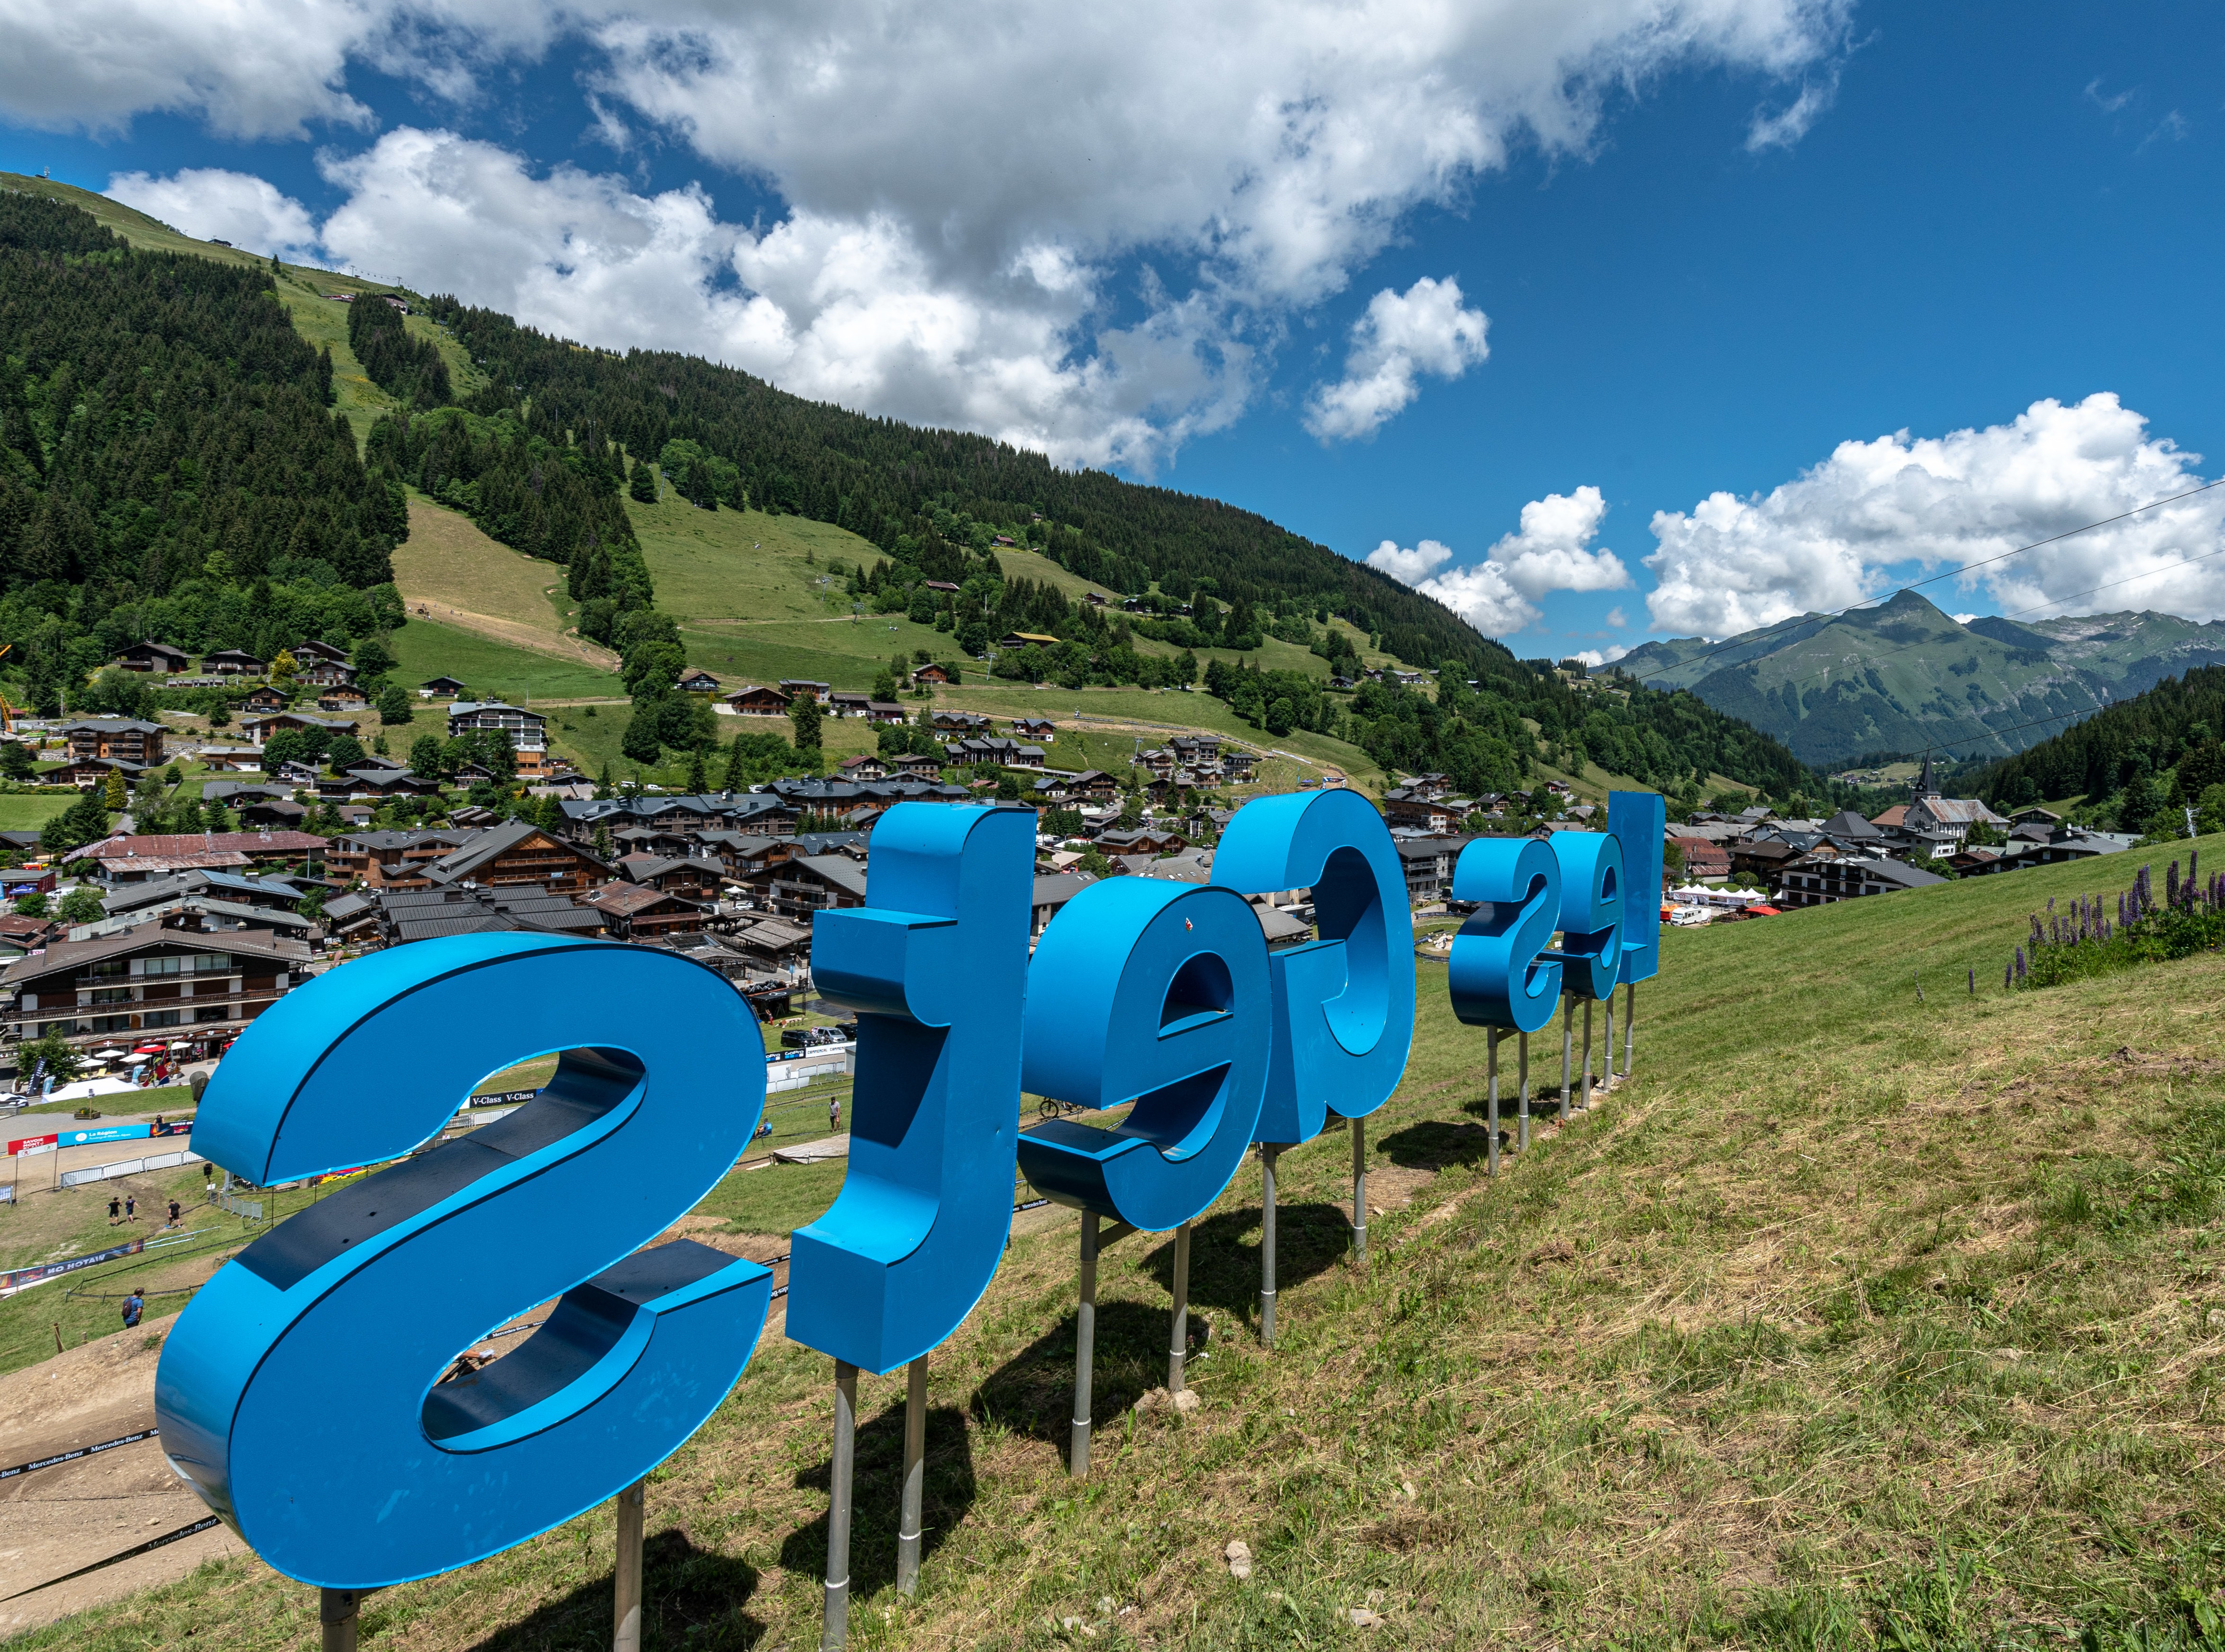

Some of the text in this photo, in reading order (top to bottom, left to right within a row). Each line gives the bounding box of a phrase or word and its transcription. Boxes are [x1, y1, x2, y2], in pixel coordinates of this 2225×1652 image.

[473, 1093, 534, 1105] V-Class V-Class
[492, 1325, 528, 1337] Mercedes-Benz
[28, 1450, 83, 1470] Mercedes-Benz
[90, 1434, 143, 1453] Mercedes-Benz
[147, 1518, 217, 1551] Mercedes-Benz
